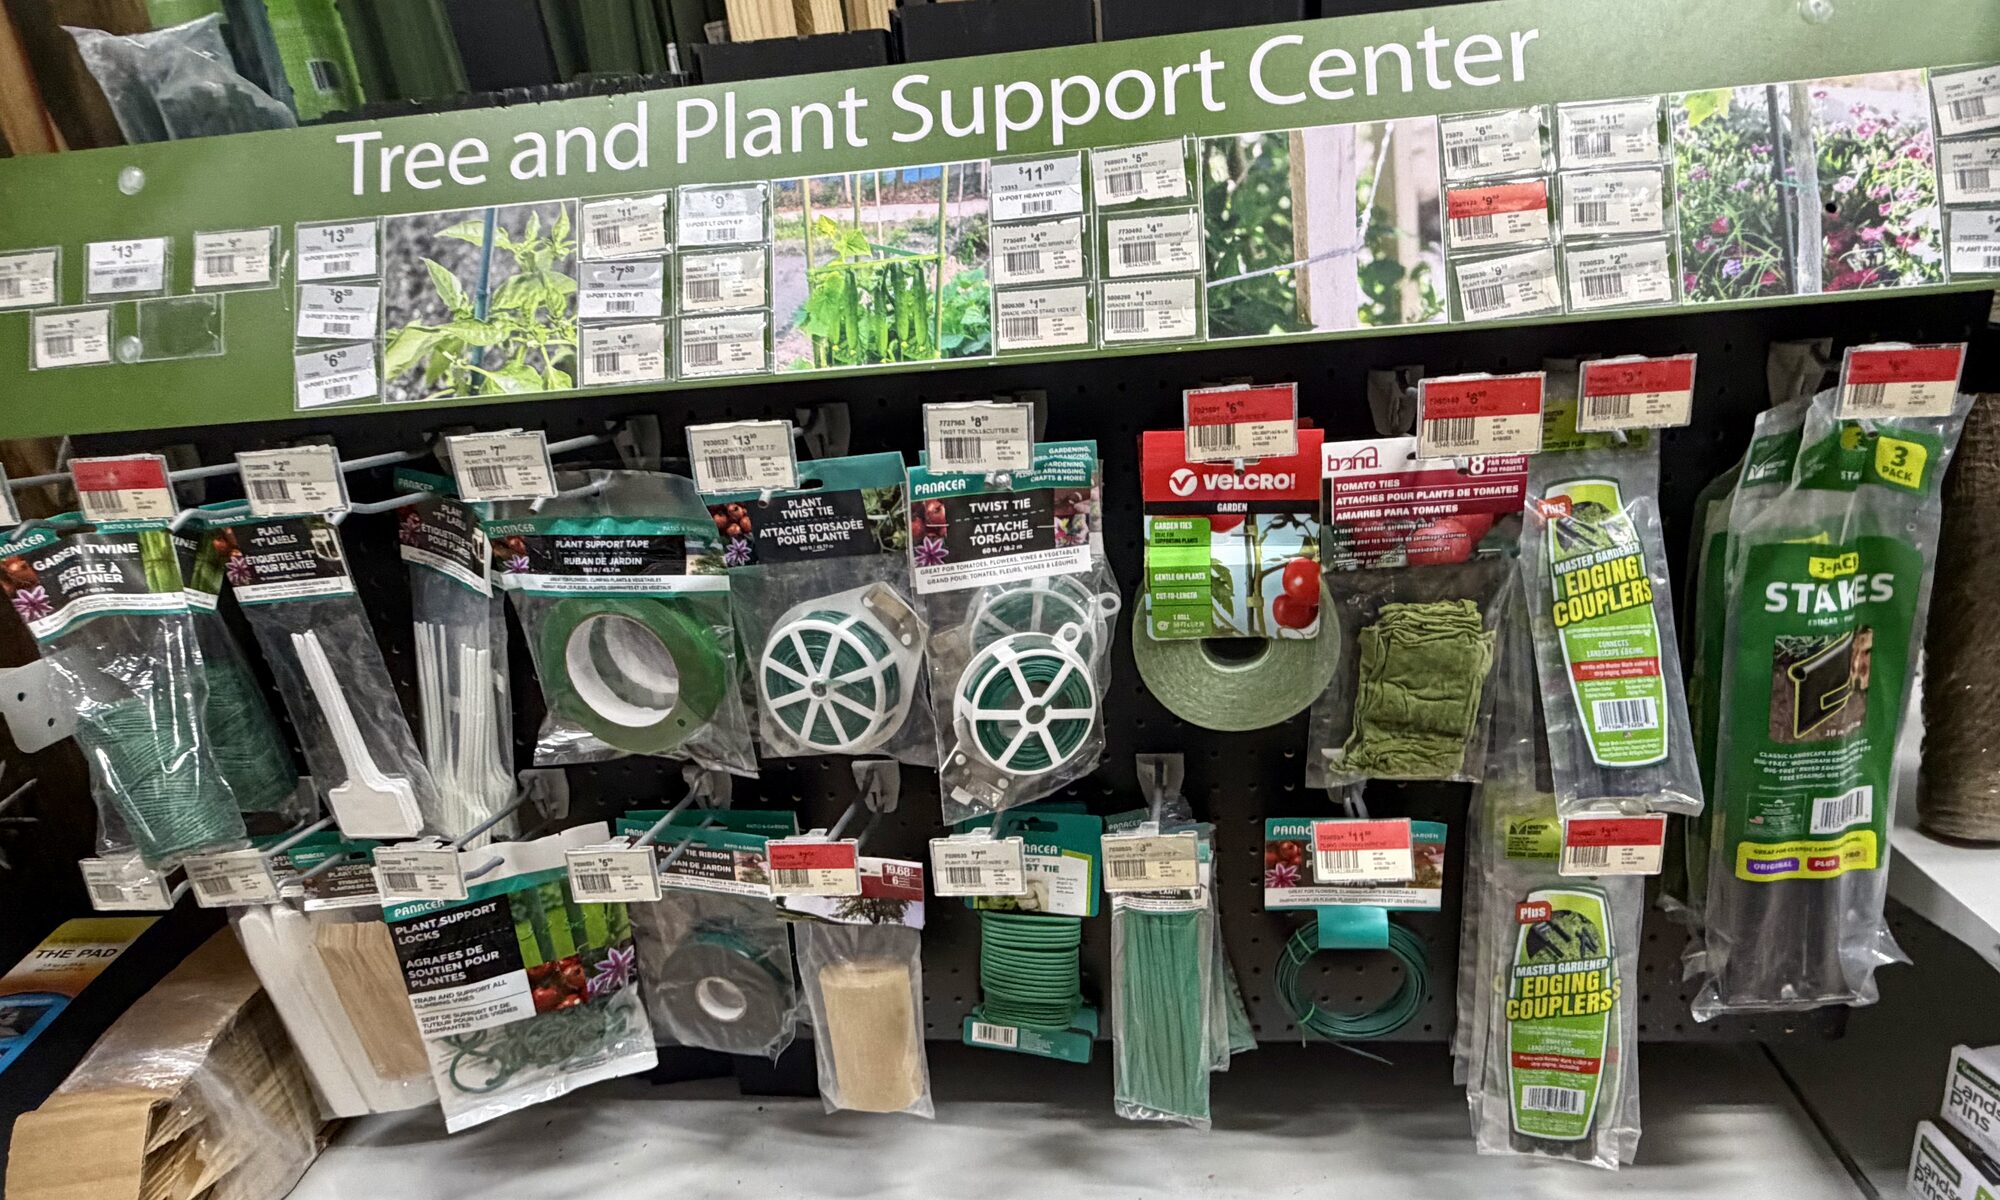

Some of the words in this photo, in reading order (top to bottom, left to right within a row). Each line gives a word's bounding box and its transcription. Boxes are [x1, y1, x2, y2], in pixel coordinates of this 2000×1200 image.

[336, 130, 488, 197] Tree
[510, 105, 648, 180] and
[677, 85, 867, 163] Plant
[890, 47, 1227, 148] Support
[1246, 26, 1541, 107] Center
[1003, 242, 1020, 250] PLANT
[1580, 266, 1597, 274] PLANT
[1463, 279, 1480, 288] PLANT
[1328, 447, 1378, 471] bond
[1470, 454, 1484, 474] 8
[1893, 446, 1909, 467] 3
[1203, 474, 1295, 490] VELCRO!
[1882, 466, 1913, 482] PACK
[915, 481, 966, 495] PANACEA
[1337, 482, 1376, 491] TOMATO
[1380, 479, 1400, 488] TIES
[787, 497, 822, 509] PLANT
[1336, 496, 1385, 505] ATTACHES
[1387, 493, 1414, 501] POUR
[1417, 490, 1455, 499] PLANTS
[1457, 489, 1471, 497] DE
[1473, 485, 1519, 496] TOMATES
[781, 508, 814, 519] TWIST
[817, 506, 834, 516] TIE
[969, 501, 1009, 513] TWIST
[1013, 498, 1031, 510] TIE
[1217, 503, 1248, 513] GARDEN
[1336, 509, 1382, 521] AMARRES
[1384, 508, 1410, 517] PARA
[1412, 504, 1458, 515] TOMATES
[257, 526, 284, 537] PLANT
[490, 525, 535, 536] PANACEA
[759, 524, 806, 538] ATTACHE
[809, 519, 864, 534] TORSADÉE
[974, 520, 1029, 534] ATTACHE
[0, 534, 45, 555] ANACEA
[267, 535, 298, 545] LABELS
[556, 540, 582, 549] PLANT
[585, 540, 624, 549] SUPPORT
[626, 540, 649, 548] TAPE
[777, 536, 807, 546] POUR
[810, 531, 850, 542] PLANTE
[970, 530, 1034, 546] TORSADEE
[85, 543, 139, 554] TWINE
[255, 564, 279, 574] POUR
[280, 560, 317, 571] PLANTES
[564, 557, 594, 565] RUBAN
[595, 557, 607, 565] DE
[609, 557, 642, 566] JARDIN
[920, 566, 940, 575] GREAT
[956, 562, 987, 570] TOMATOES,
[1044, 548, 1080, 557] VEGETABLES
[1555, 557, 1594, 575] MASTER
[58, 564, 106, 584] FCELLE
[110, 562, 121, 573] À
[927, 576, 949, 585] GRAND
[950, 573, 969, 582] POUR:
[970, 570, 998, 579] TOMATES,
[999, 566, 1022, 575] FLEURS,
[1565, 556, 1639, 596] EDGING
[1764, 573, 1895, 614] STAKES
[1552, 578, 1653, 627] COUPLERS
[699, 851, 730, 860] RIBBON
[702, 864, 731, 872] JARDIN
[1043, 865, 1060, 873] TIE
[1753, 862, 1793, 870] ORIGINAL
[892, 876, 898, 884] 6
[394, 899, 446, 918] PANACEA
[1520, 906, 1546, 919] Plus
[395, 919, 437, 935] PLANT
[439, 903, 497, 929] SUPPORT
[399, 930, 440, 945] LOCKS
[35, 950, 73, 959] THE
[76, 949, 118, 958] PAD
[405, 951, 463, 969] AGRAFES
[466, 944, 484, 957] DE
[408, 961, 462, 979] SOUTIEN
[464, 951, 499, 967] POUR
[1516, 962, 1556, 976] MASTER
[1557, 957, 1608, 973] GARDENER
[411, 972, 467, 988] PLANTES
[1522, 971, 1599, 997] EDGING
[439, 992, 454, 1000] AND
[456, 984, 492, 997] SUPPORT
[493, 980, 508, 989] ALL
[1506, 990, 1612, 1021] COUPLERS
[478, 1012, 490, 1020] LES
[1950, 1090, 1991, 1132] Pins
